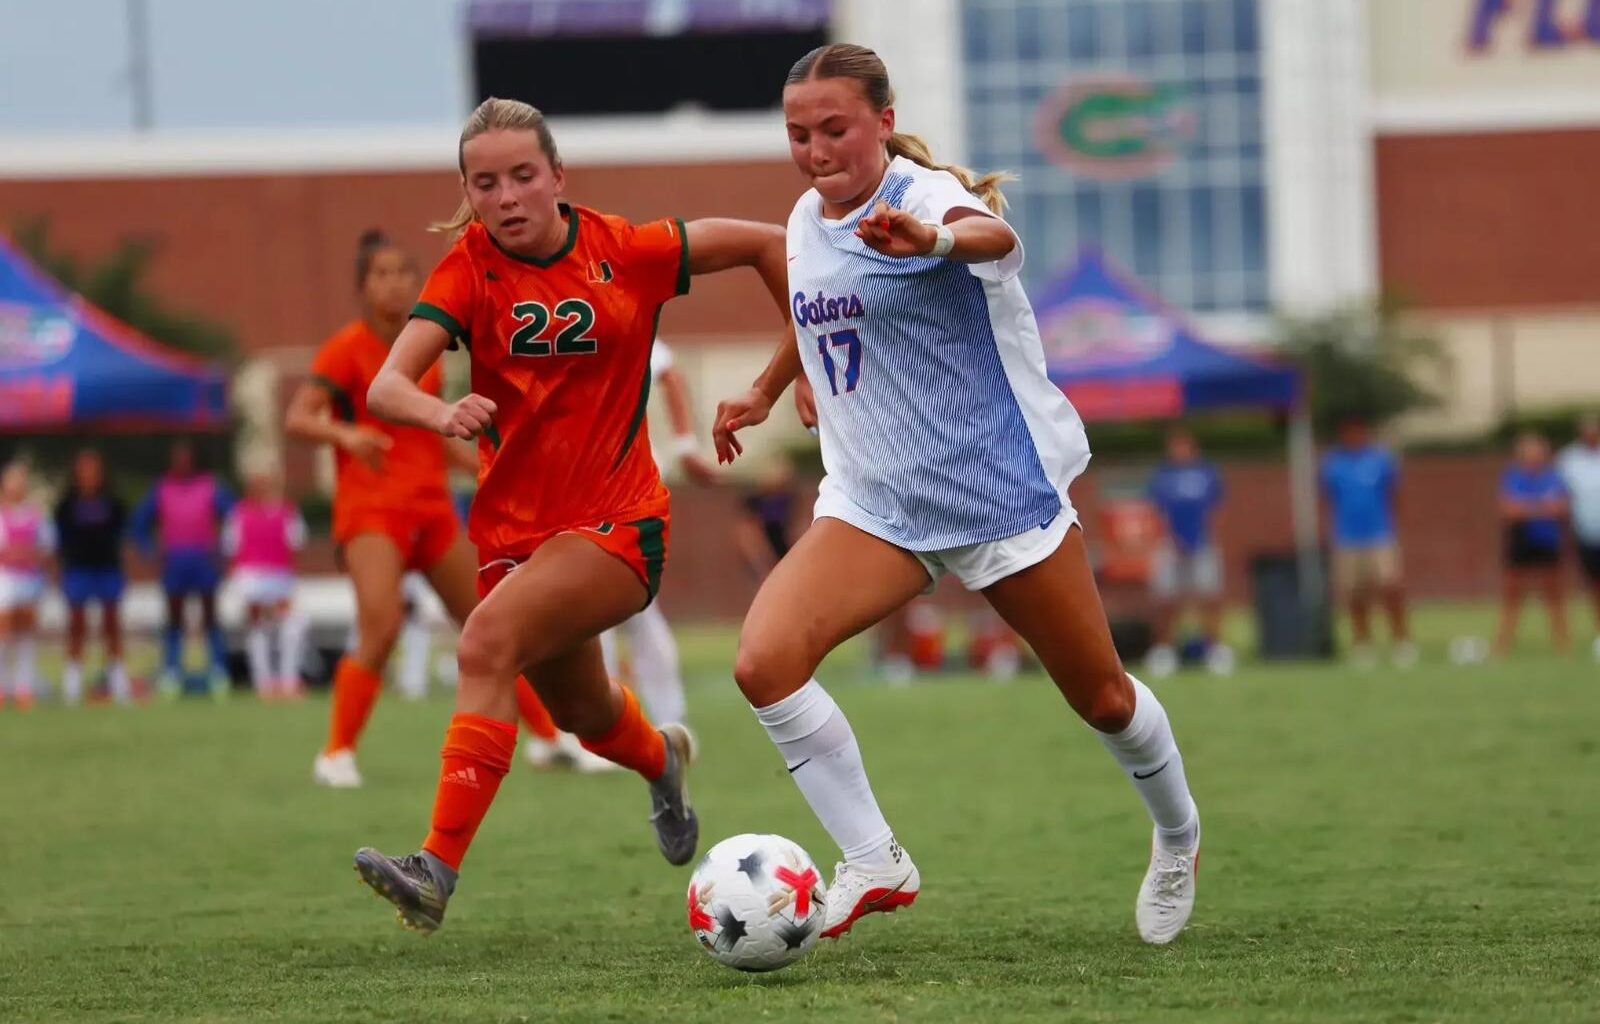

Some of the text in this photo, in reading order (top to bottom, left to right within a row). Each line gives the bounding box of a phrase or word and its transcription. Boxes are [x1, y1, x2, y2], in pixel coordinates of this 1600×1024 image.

[510, 298, 597, 357] 22
[793, 291, 865, 328] Gators
[817, 328, 862, 396] 17
